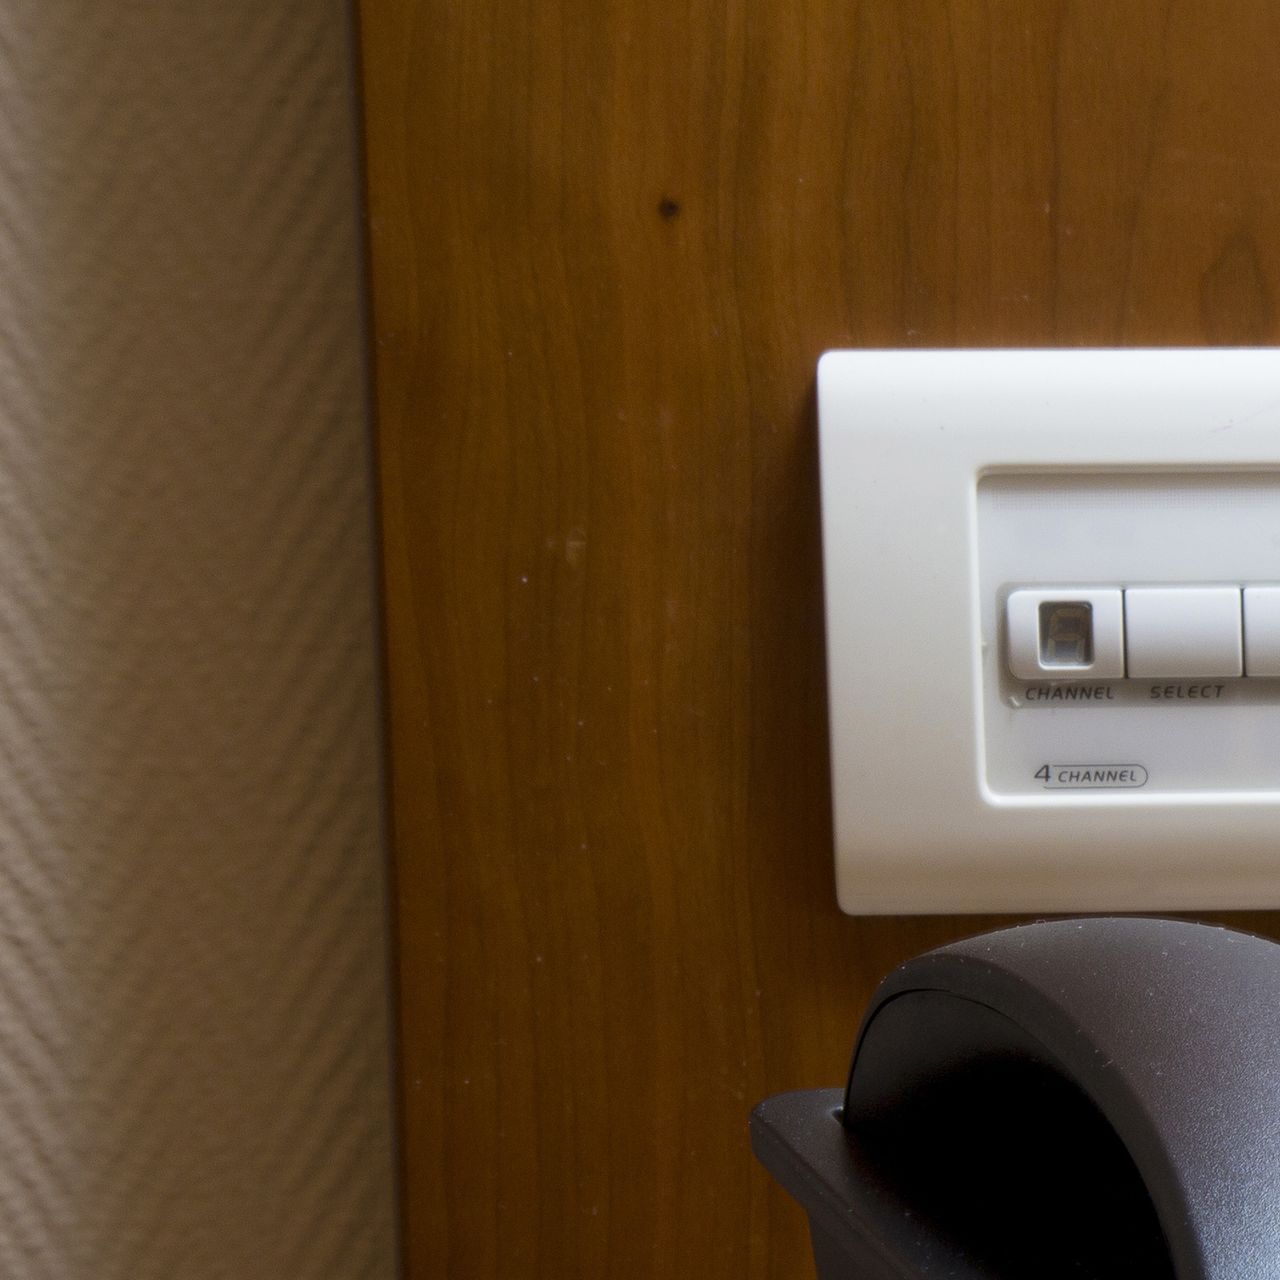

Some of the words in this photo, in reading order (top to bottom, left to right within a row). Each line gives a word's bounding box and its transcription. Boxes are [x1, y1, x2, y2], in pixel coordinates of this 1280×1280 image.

[1026, 687, 1115, 701] CHANNEL
[1151, 685, 1225, 699] SELECT
[1034, 764, 1052, 783] 4
[1058, 770, 1138, 784] CHANNEL
